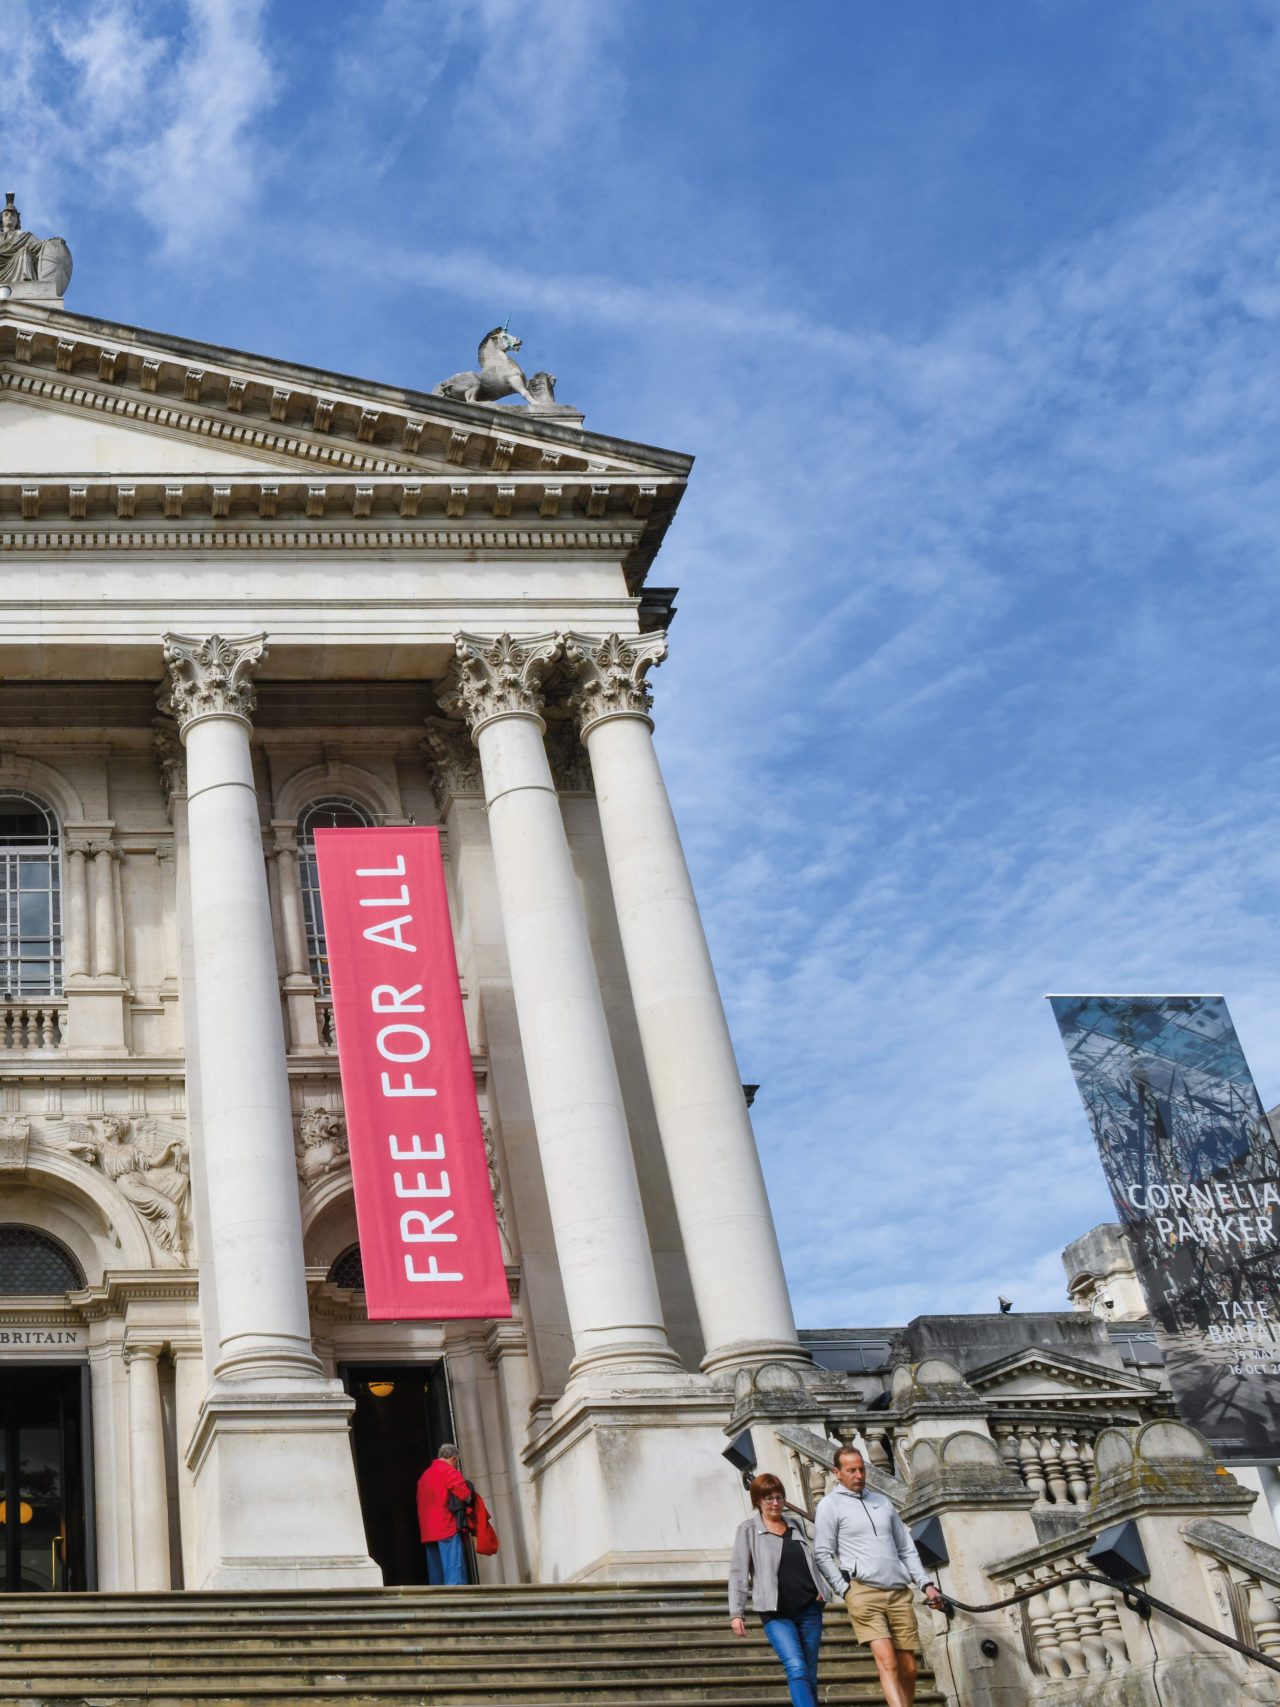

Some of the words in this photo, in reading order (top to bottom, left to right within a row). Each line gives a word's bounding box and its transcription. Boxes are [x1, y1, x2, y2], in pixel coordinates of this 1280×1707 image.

[355, 854, 417, 952] ALL
[371, 984, 437, 1097] FOR
[389, 1132, 463, 1283] FREE
[1128, 1183, 1280, 1209] CORNELIA
[1155, 1216, 1278, 1242] PARKER
[1217, 1301, 1270, 1319] TATE
[0, 1332, 77, 1344] BRITAIN
[1208, 1324, 1280, 1344] BRITAI
[1232, 1350, 1246, 1360] 19
[1250, 1350, 1274, 1360] MAY
[1228, 1364, 1242, 1375] 16
[1246, 1364, 1267, 1375] OCT
